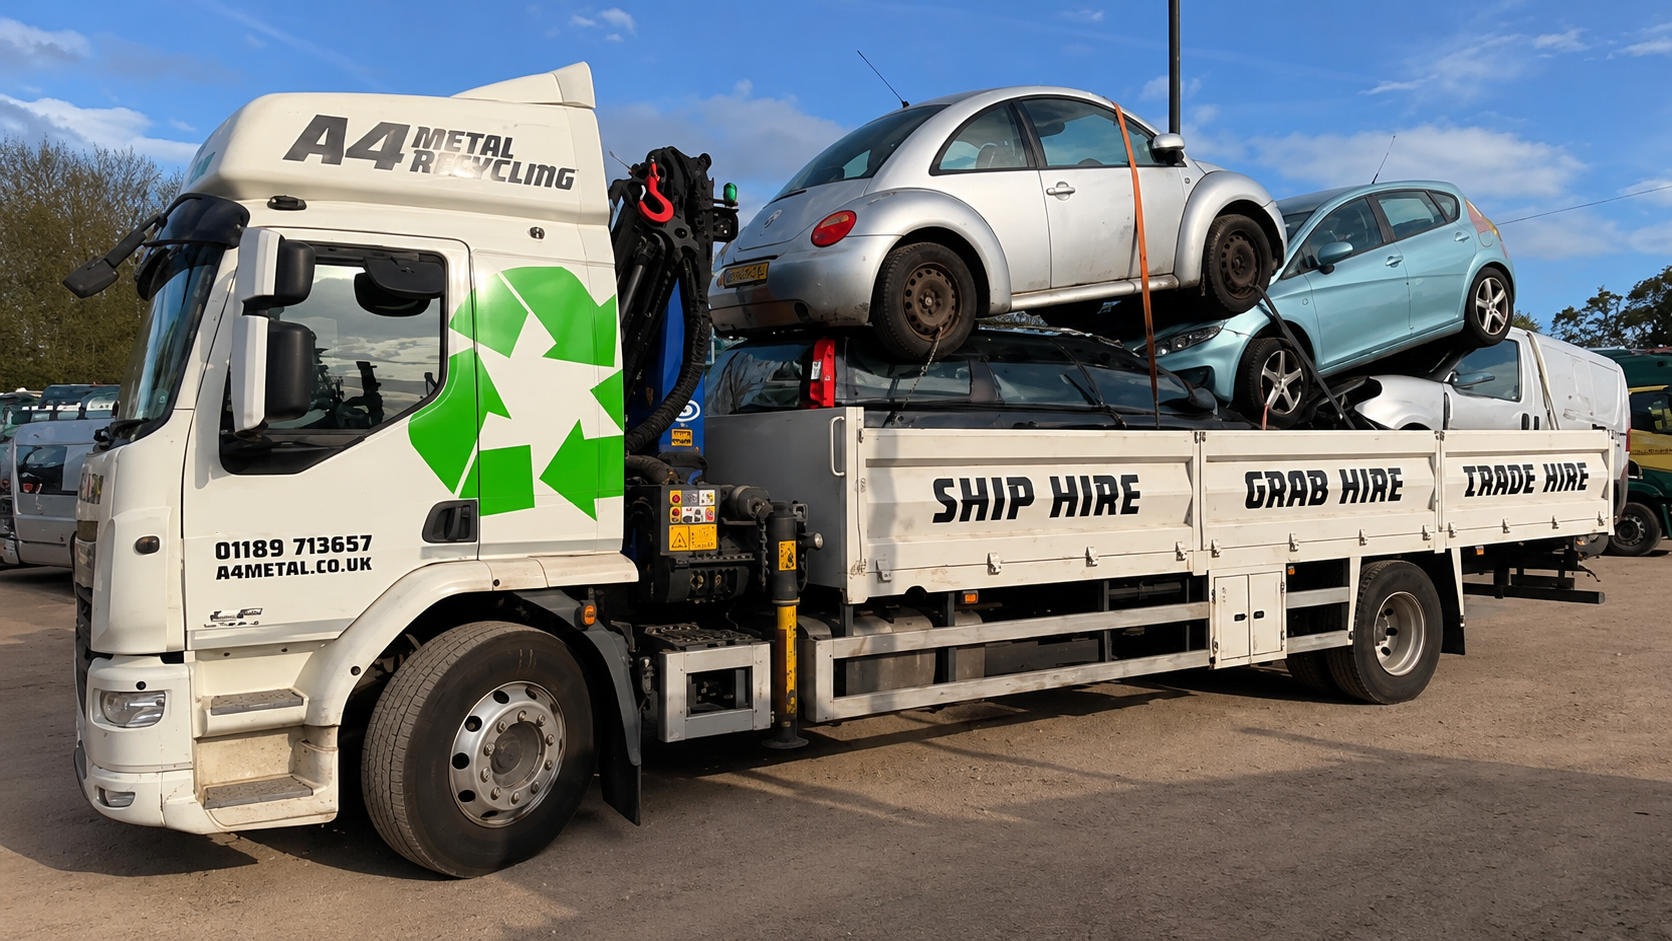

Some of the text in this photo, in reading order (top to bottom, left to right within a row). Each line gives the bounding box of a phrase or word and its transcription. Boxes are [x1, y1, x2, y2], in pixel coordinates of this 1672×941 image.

[282, 114, 412, 171] A4
[411, 126, 515, 160] METAL
[409, 150, 577, 191] RECYCLING
[1244, 467, 1404, 510] GRAB HIRE
[1542, 462, 1590, 493] HIRE
[931, 473, 1141, 524] SHIP HIRE
[215, 534, 373, 560] 01189 713657
[215, 556, 373, 581] A4METAL.CO.UK
